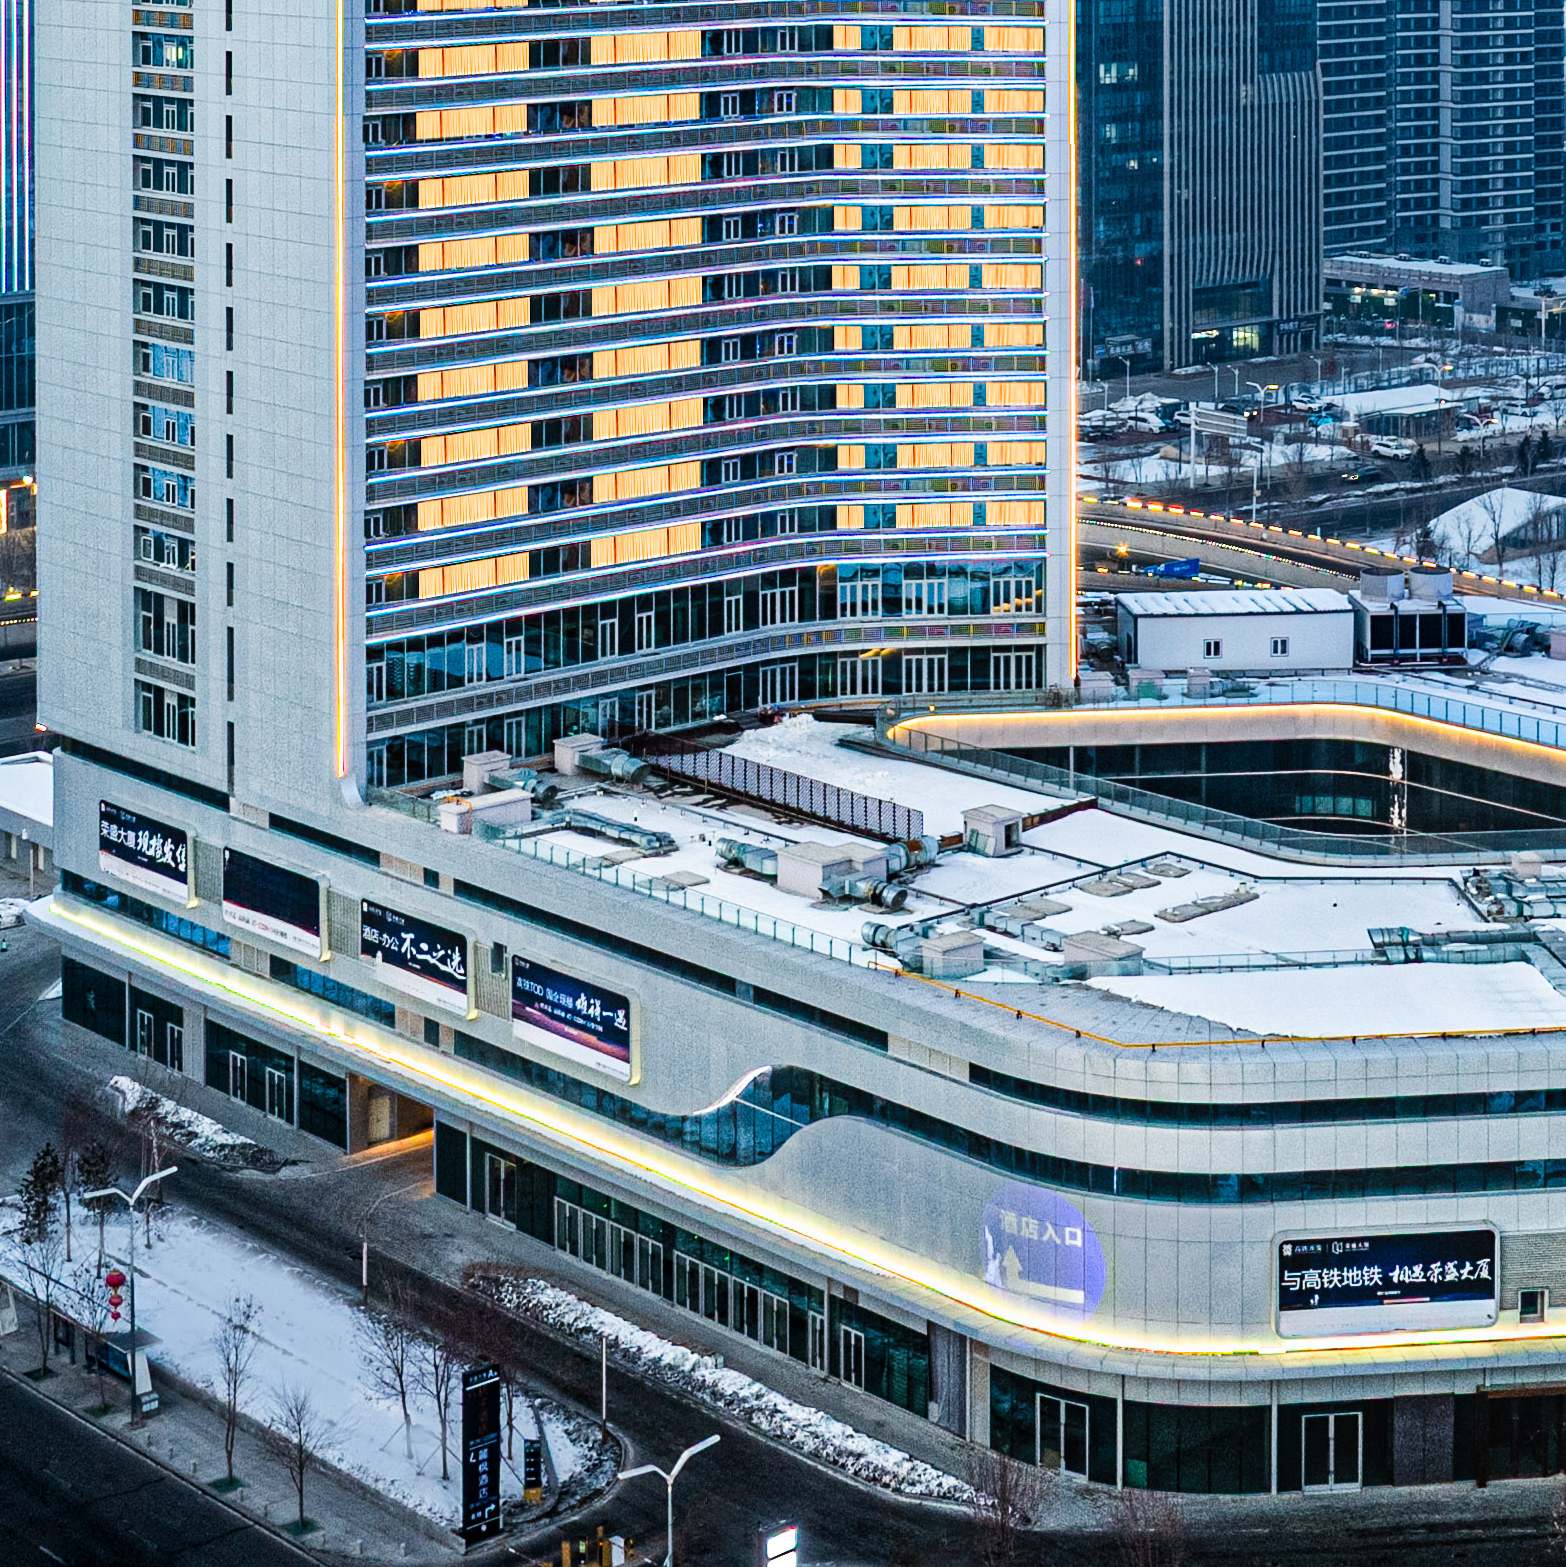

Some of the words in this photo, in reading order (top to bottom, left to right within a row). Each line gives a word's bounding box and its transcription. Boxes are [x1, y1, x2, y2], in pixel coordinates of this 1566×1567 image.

[400, 932, 467, 980] 不二之选
[999, 1209, 1082, 1248] 酒店入口
[1281, 1265, 1383, 1291] 与高铁地铁
[1389, 1258, 1492, 1284] 相遇荣盛大厦
